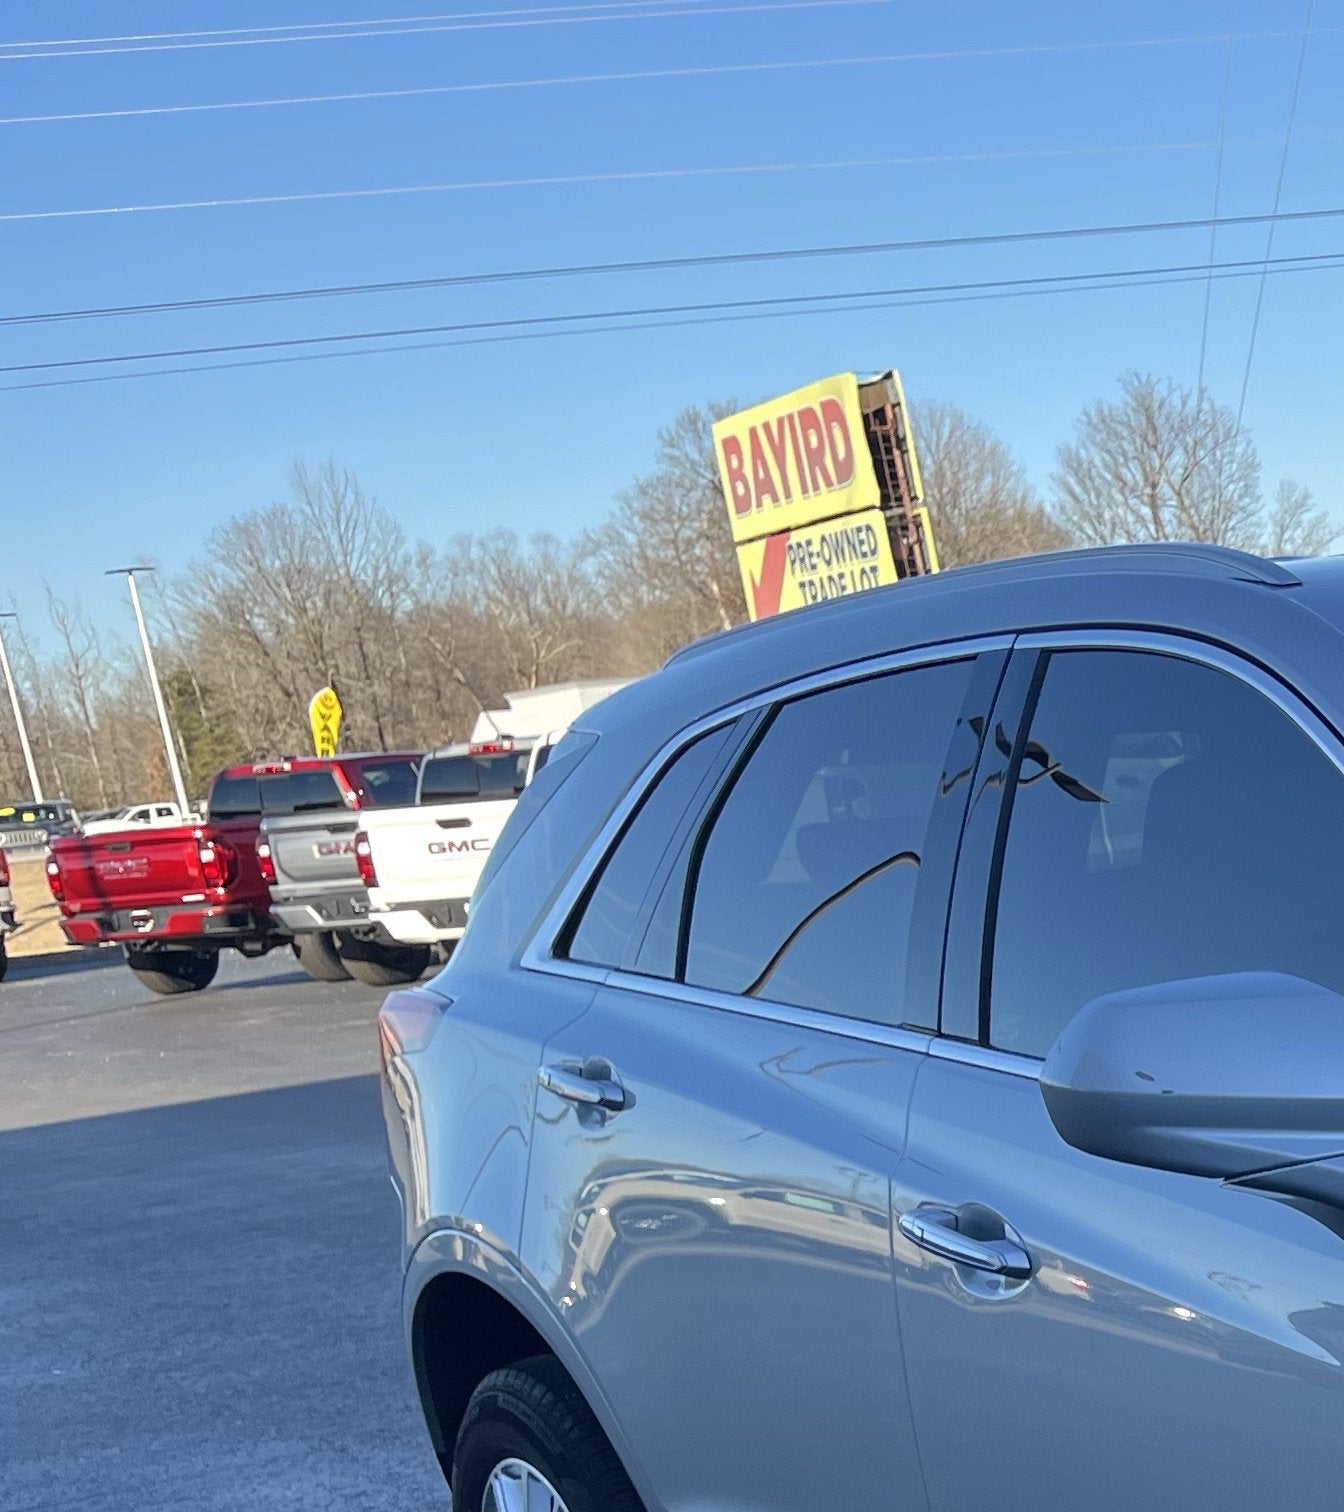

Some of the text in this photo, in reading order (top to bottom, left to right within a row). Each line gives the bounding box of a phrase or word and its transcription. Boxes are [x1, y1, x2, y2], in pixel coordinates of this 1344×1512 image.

[721, 398, 855, 516] BAYIRD
[788, 524, 878, 575] PRE-OWNED
[428, 838, 491, 854] GMC
